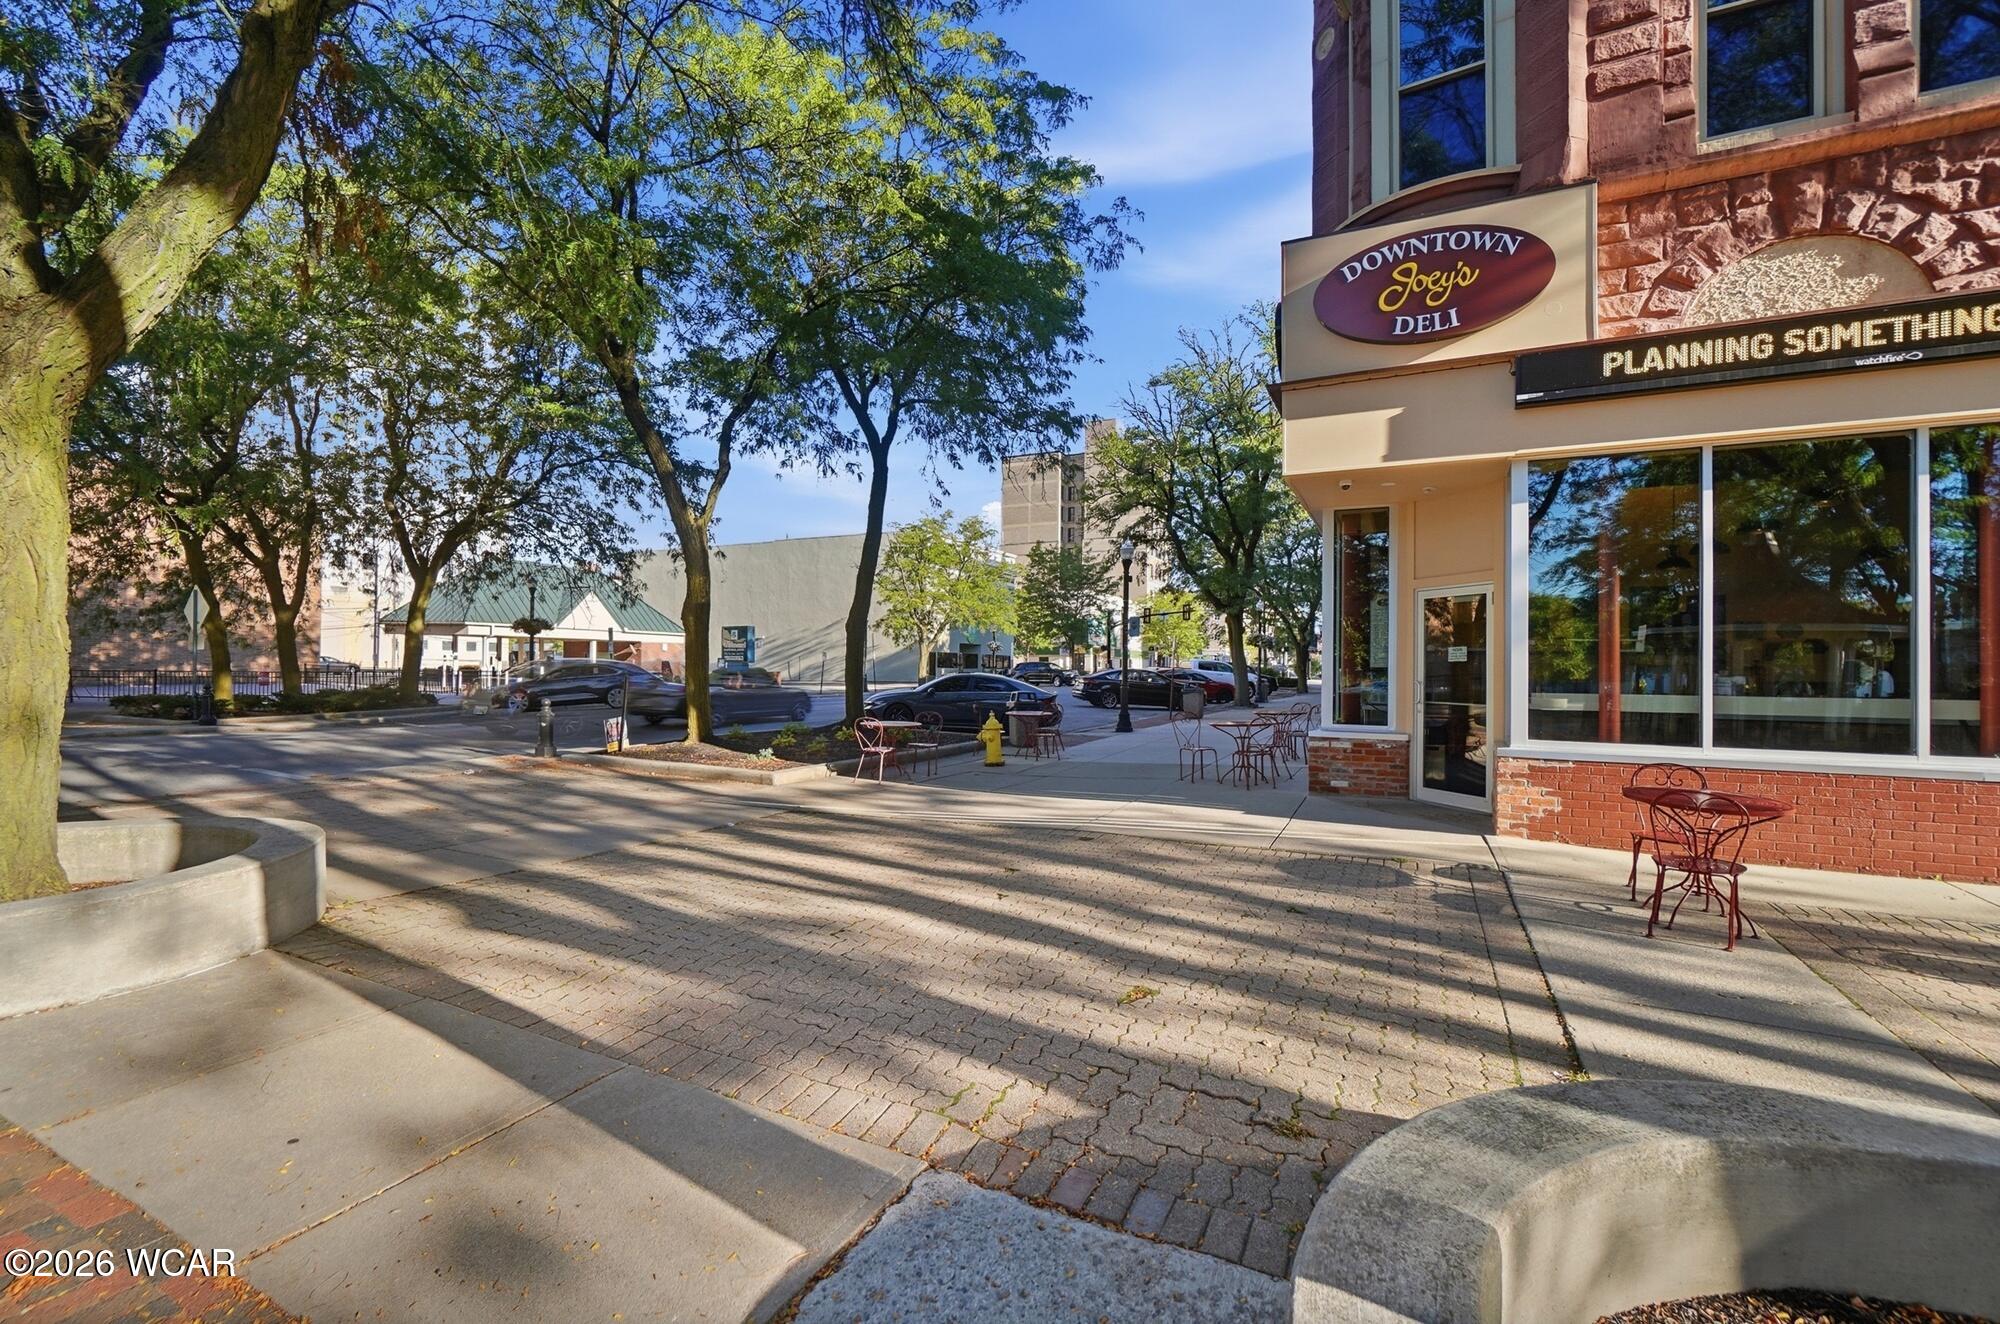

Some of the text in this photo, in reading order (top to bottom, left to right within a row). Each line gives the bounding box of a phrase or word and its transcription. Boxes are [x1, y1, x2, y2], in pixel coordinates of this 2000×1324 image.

[1340, 230, 1524, 283] DOWNTOWN
[1378, 261, 1480, 312] Joey's
[1392, 307, 1461, 335] DELI
[1602, 303, 2000, 378] PLANNING SOMETHING
[1855, 354, 1903, 366] watchfire
